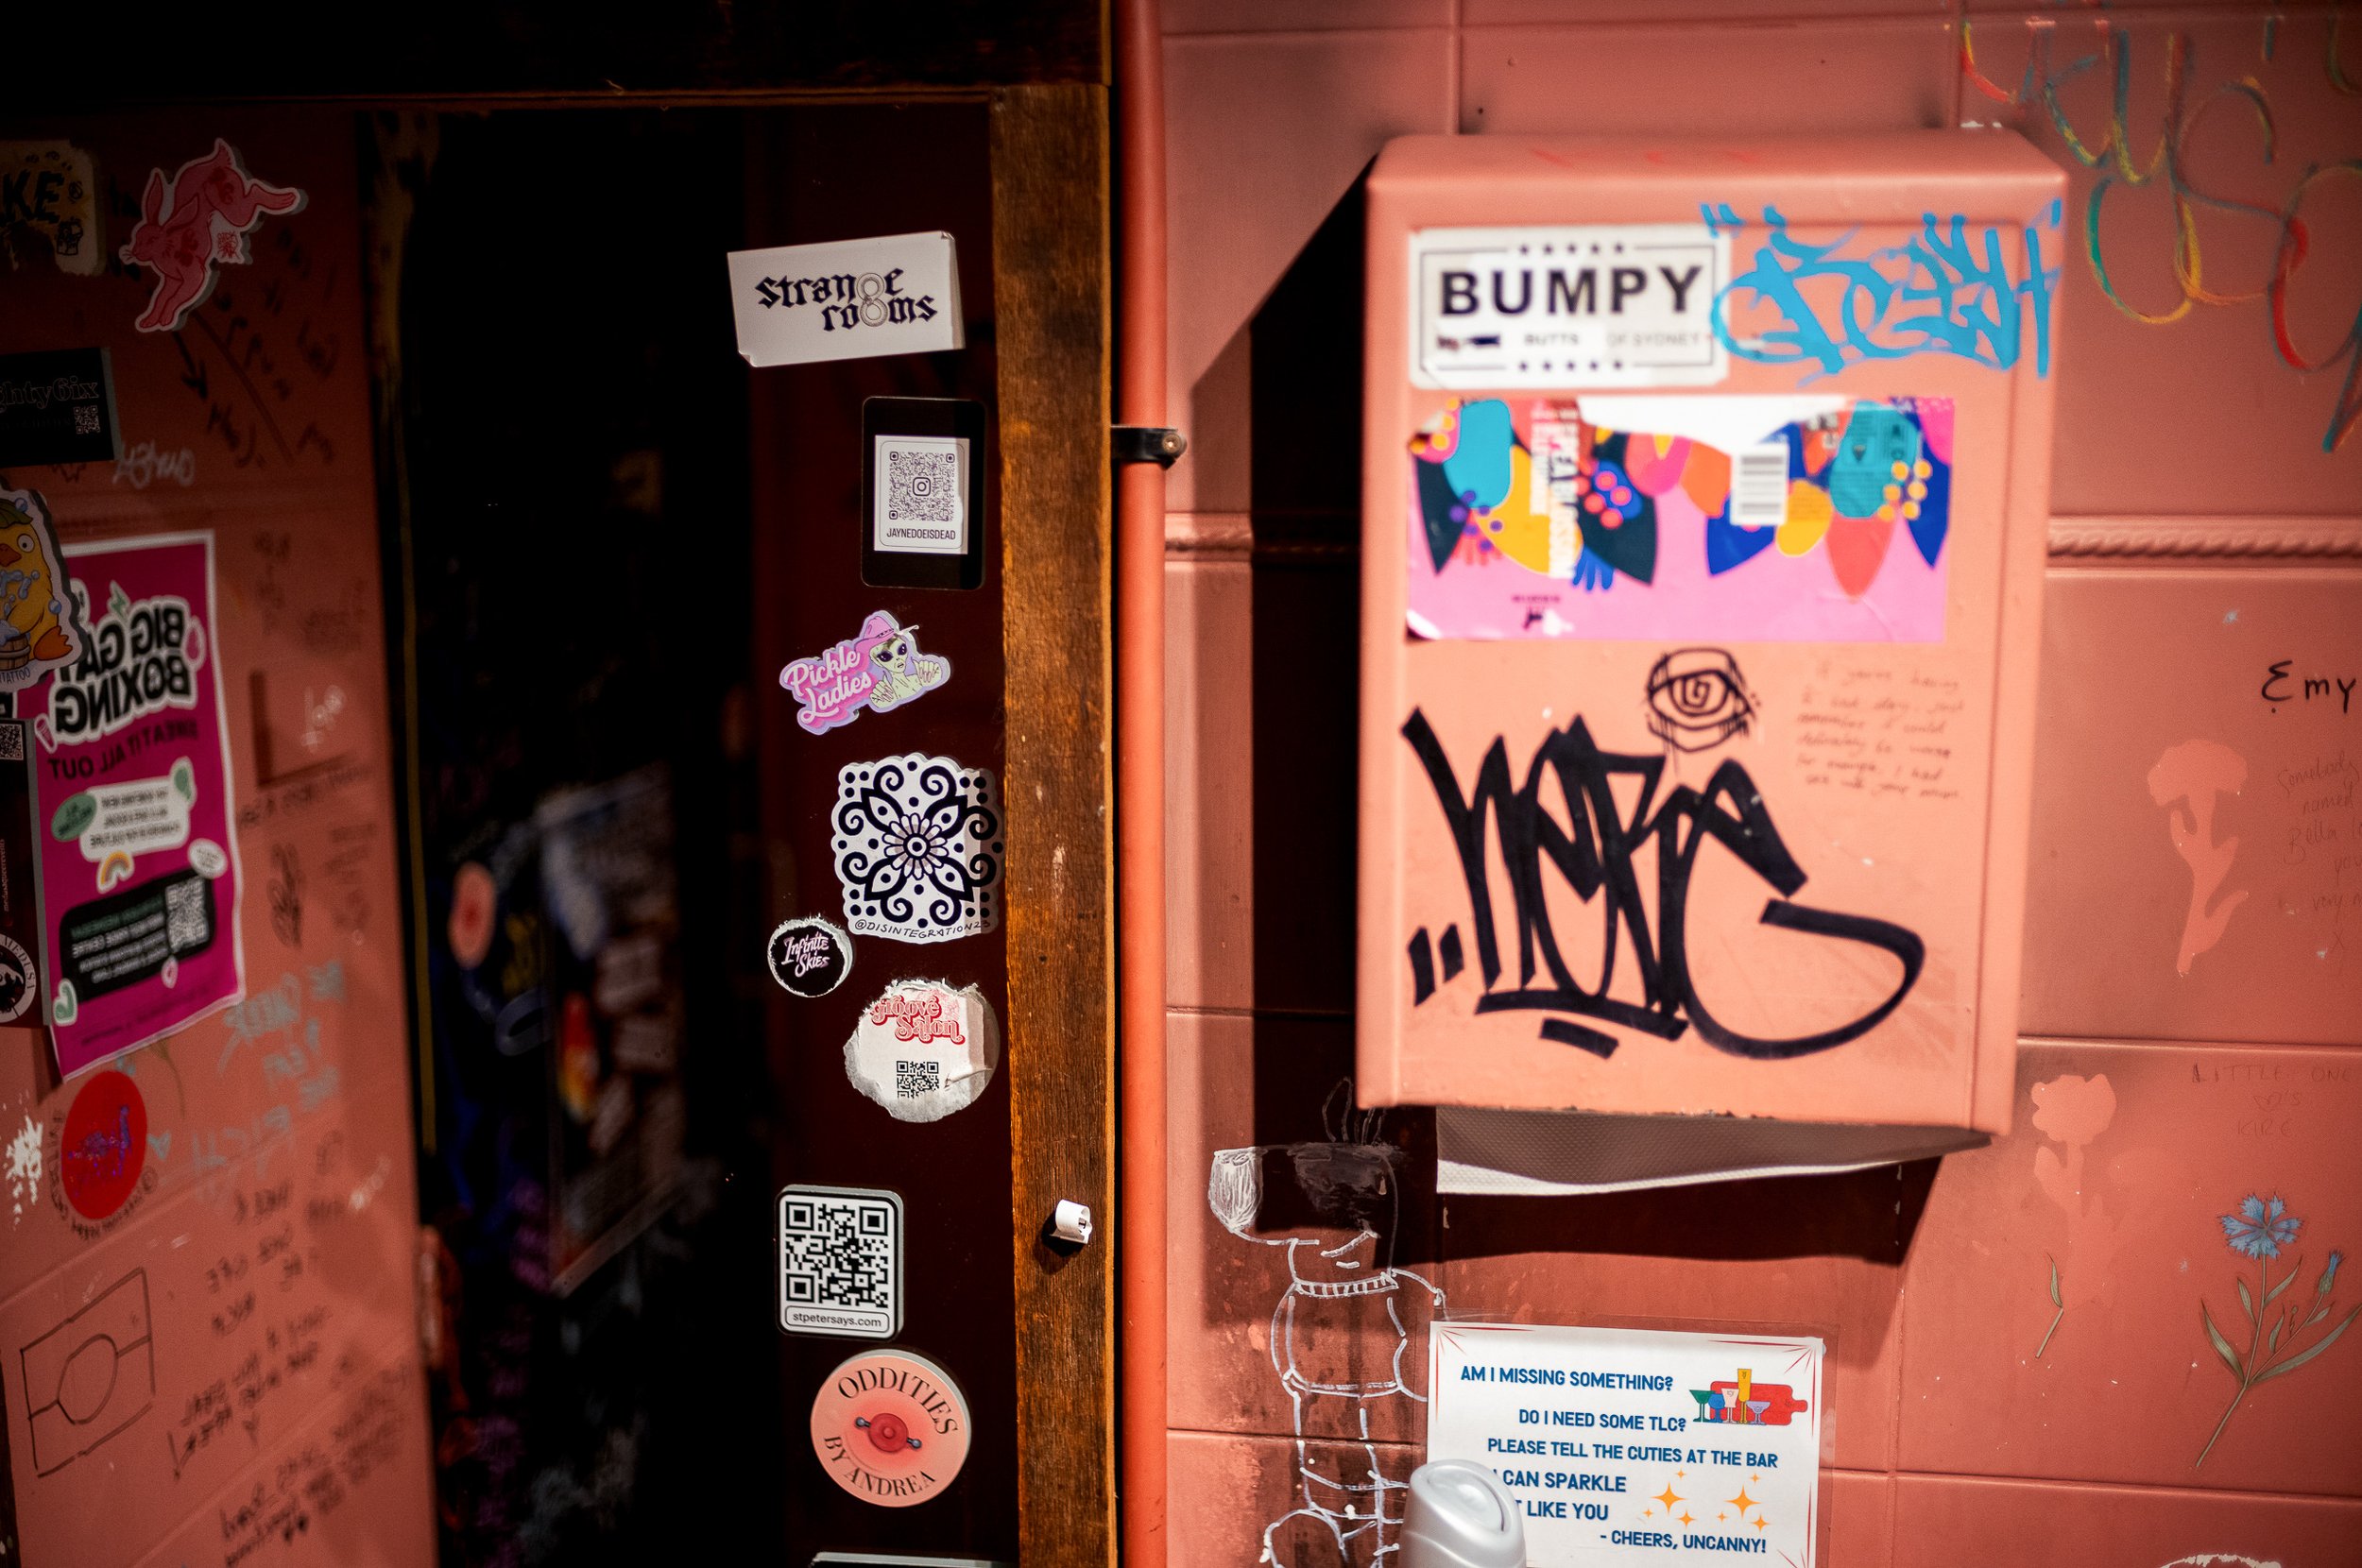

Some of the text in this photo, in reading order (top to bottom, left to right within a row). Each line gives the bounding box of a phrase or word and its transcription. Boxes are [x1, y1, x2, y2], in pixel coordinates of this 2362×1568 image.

[1441, 265, 1702, 316] BUMPY
[886, 527, 956, 541] JAYNEDOEISDEAD
[788, 645, 861, 695] Pickle
[799, 671, 872, 724] Ladies
[853, 917, 991, 940] @DISINTEGRATION23
[780, 930, 829, 964] Infinite
[795, 950, 830, 978] Skies
[870, 995, 943, 1026] groove
[895, 1014, 966, 1045] Salon
[792, 1311, 881, 1328] stpetersays.com
[1461, 1365, 1673, 1391] AM I MISSING SOMETHING?
[837, 1366, 959, 1437] ODDITIES
[1519, 1409, 1686, 1432] DO I NEED SOME TLC?
[823, 1435, 936, 1497] BY ANDREA
[1487, 1438, 1777, 1469] PLEASE TELL THE CUTIES AT THE BAR
[1502, 1470, 1627, 1492] CAN SPARKLE
[1527, 1500, 1608, 1521] LIKE YOU
[1612, 1529, 1678, 1550] CHEERS,
[1683, 1533, 1767, 1554] UNCANNY!
